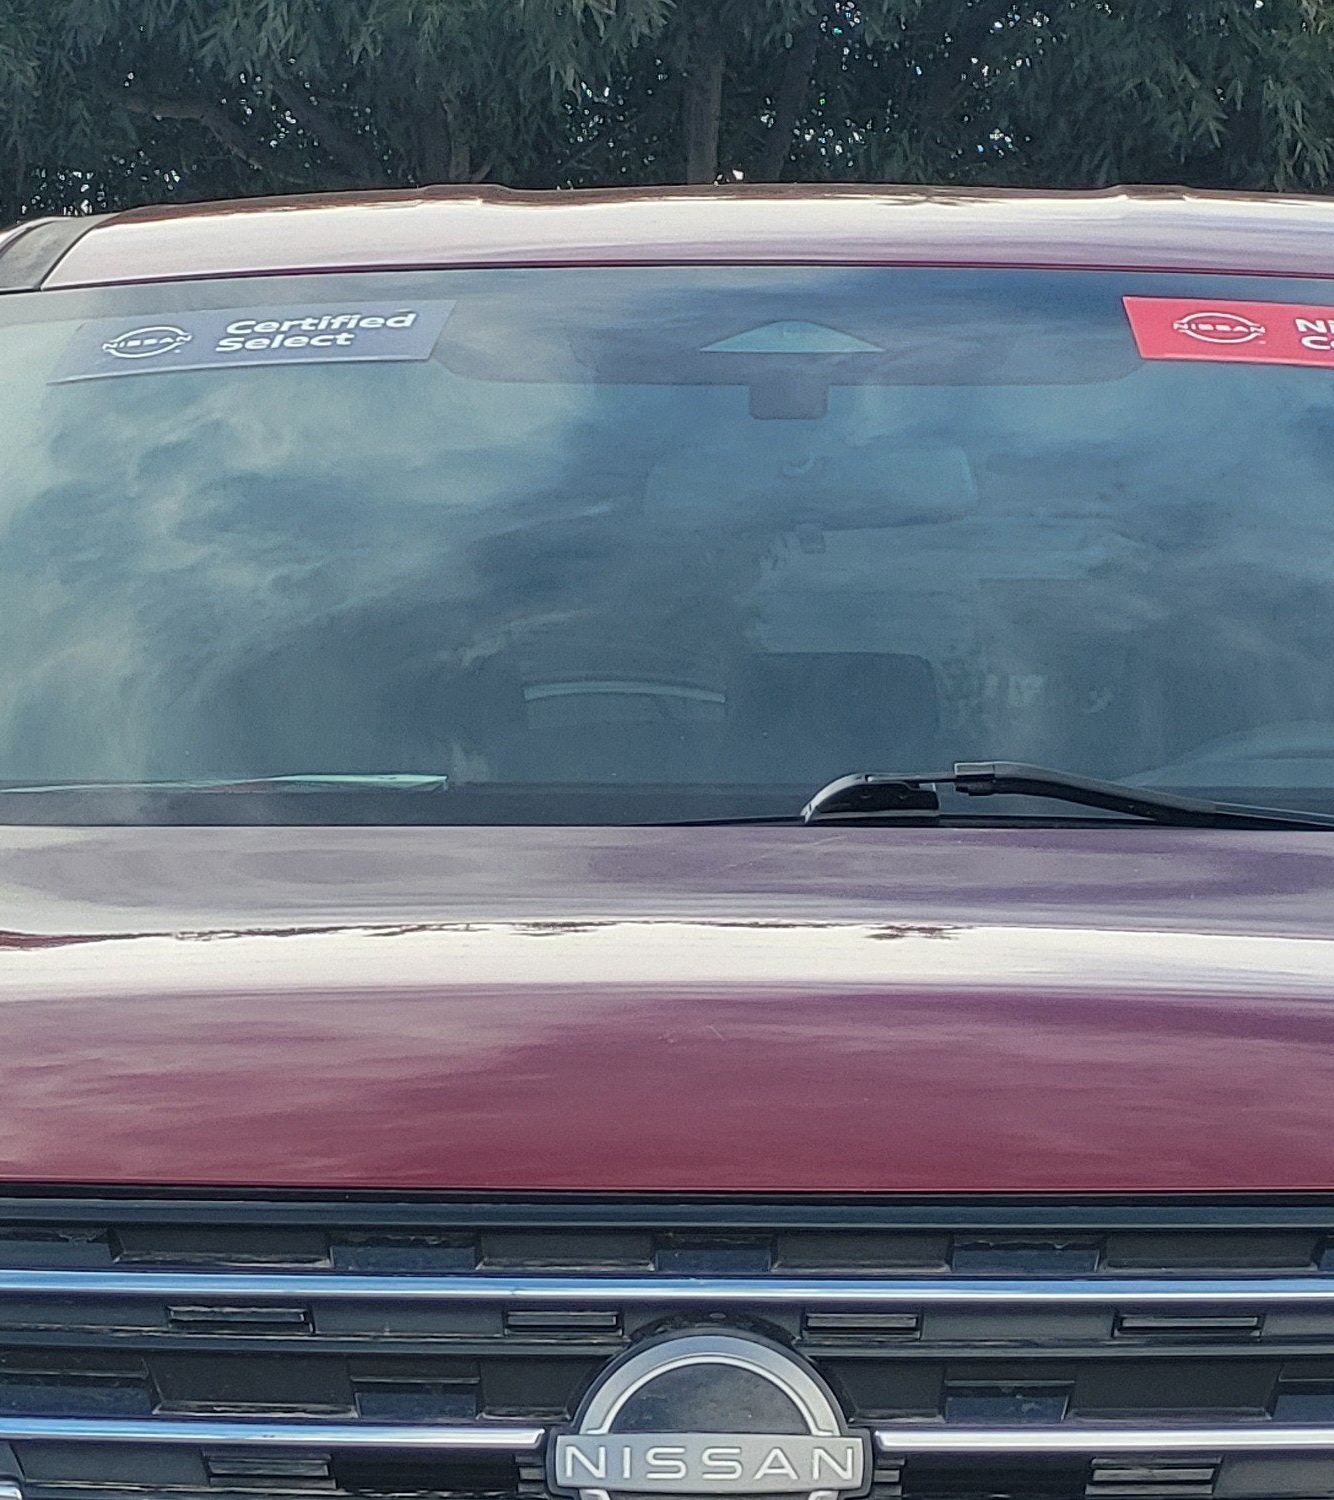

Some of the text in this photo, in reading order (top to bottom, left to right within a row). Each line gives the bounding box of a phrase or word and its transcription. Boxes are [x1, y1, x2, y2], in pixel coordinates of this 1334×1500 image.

[226, 312, 417, 334] Certified
[215, 332, 355, 354] Select
[564, 1446, 855, 1481] NISSAN
